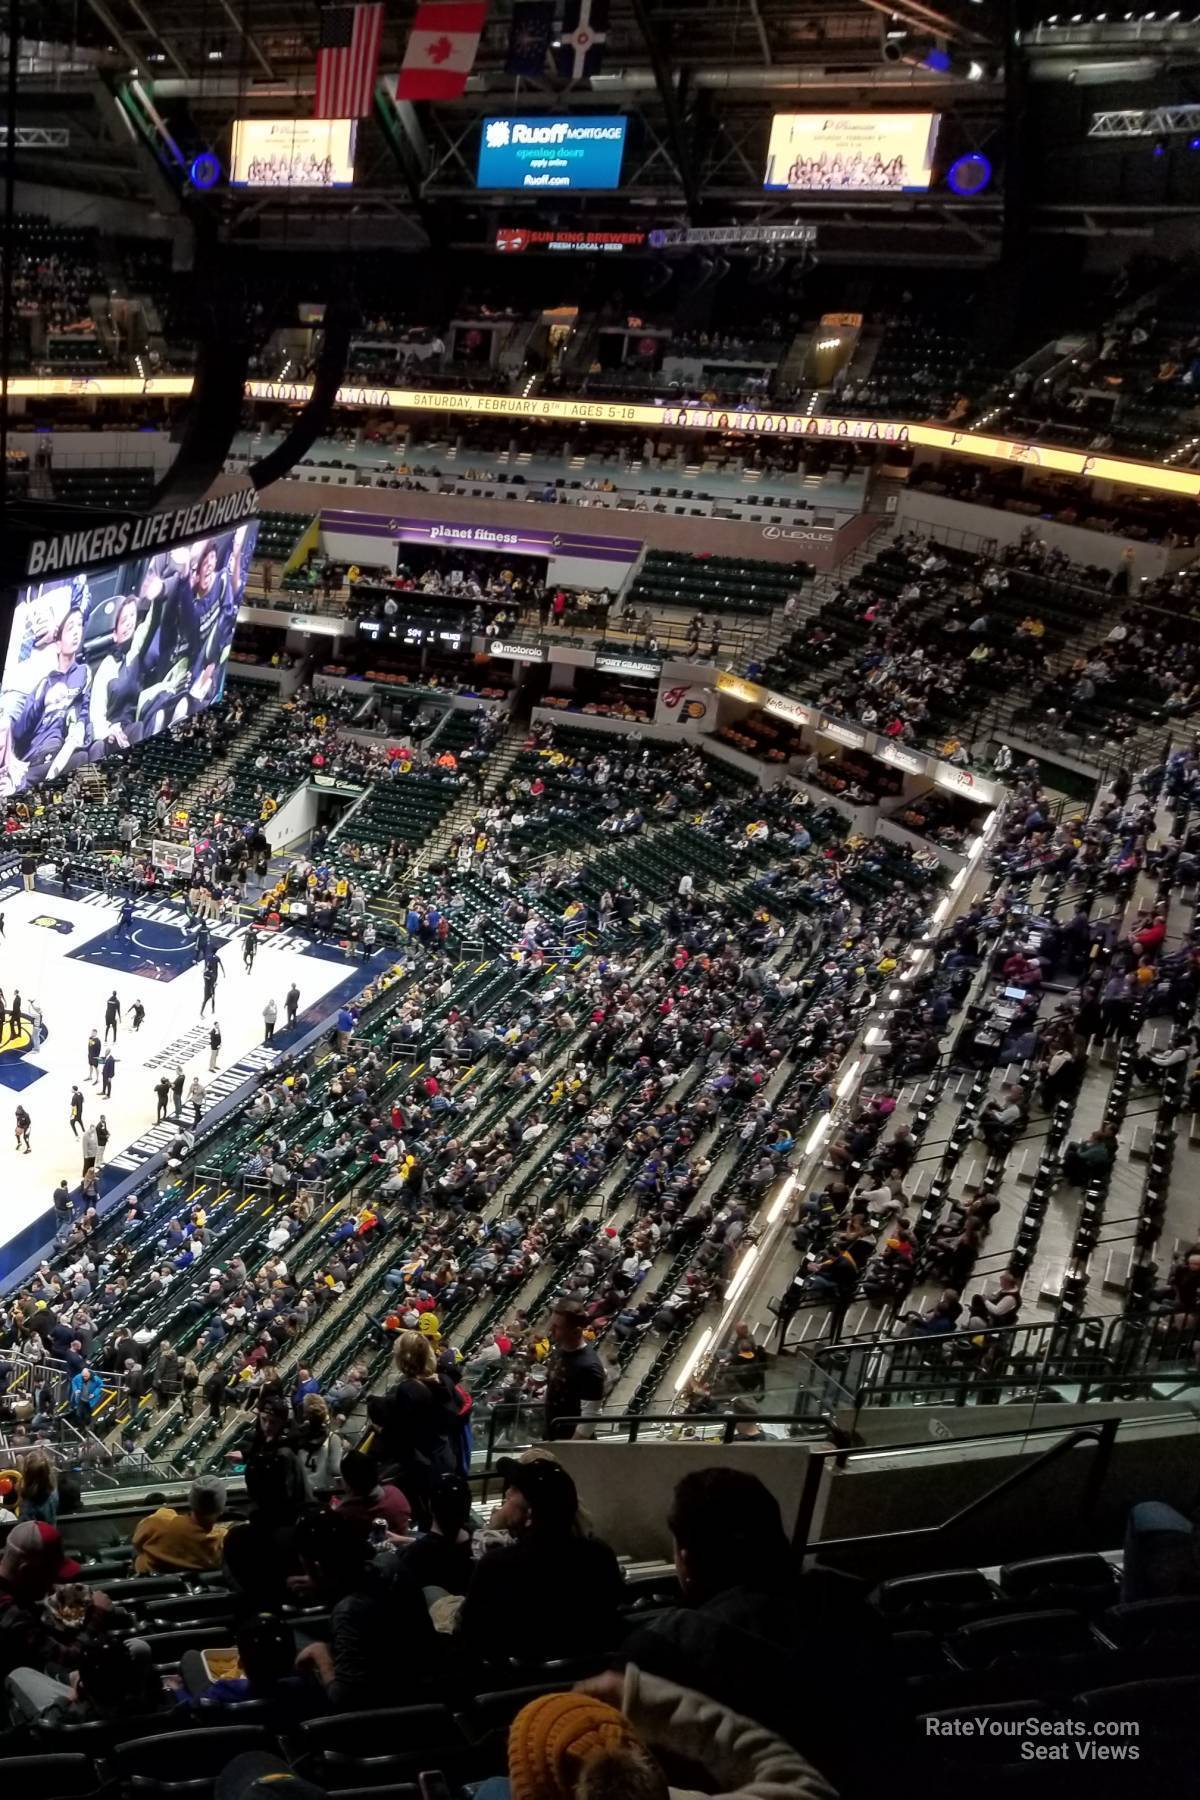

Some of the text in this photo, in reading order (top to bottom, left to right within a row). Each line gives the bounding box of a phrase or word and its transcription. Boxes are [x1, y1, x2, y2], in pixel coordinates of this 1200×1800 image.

[512, 123, 622, 144] Ruoff MORTGAGE
[516, 147, 584, 160] opening doors
[524, 175, 570, 186] Ruoff.com
[531, 231, 645, 244] SUN KING BREWERY
[548, 242, 571, 250] FRESH
[575, 242, 599, 251] LOCAL
[413, 394, 474, 412] SATURDAY,
[477, 398, 540, 413] FEBRUARY
[571, 404, 603, 417] AGES
[608, 406, 635, 419] 5-18
[28, 488, 260, 575] BANKERS LIFE FIELDHOUSE
[430, 525, 518, 544] planet fitness
[782, 530, 833, 542] LEXUS
[371, 631, 377, 639] 0
[504, 645, 543, 657] motorola
[596, 657, 661, 672] SPORT GRAPHICS
[78, 891, 190, 928] INDANA
[143, 1025, 210, 1069] BANKERS LIFE
[162, 1034, 211, 1071] FIELDHOUS
[109, 1150, 150, 1172] WE
[132, 1121, 181, 1154] GROW
[238, 1045, 283, 1070] HERE
